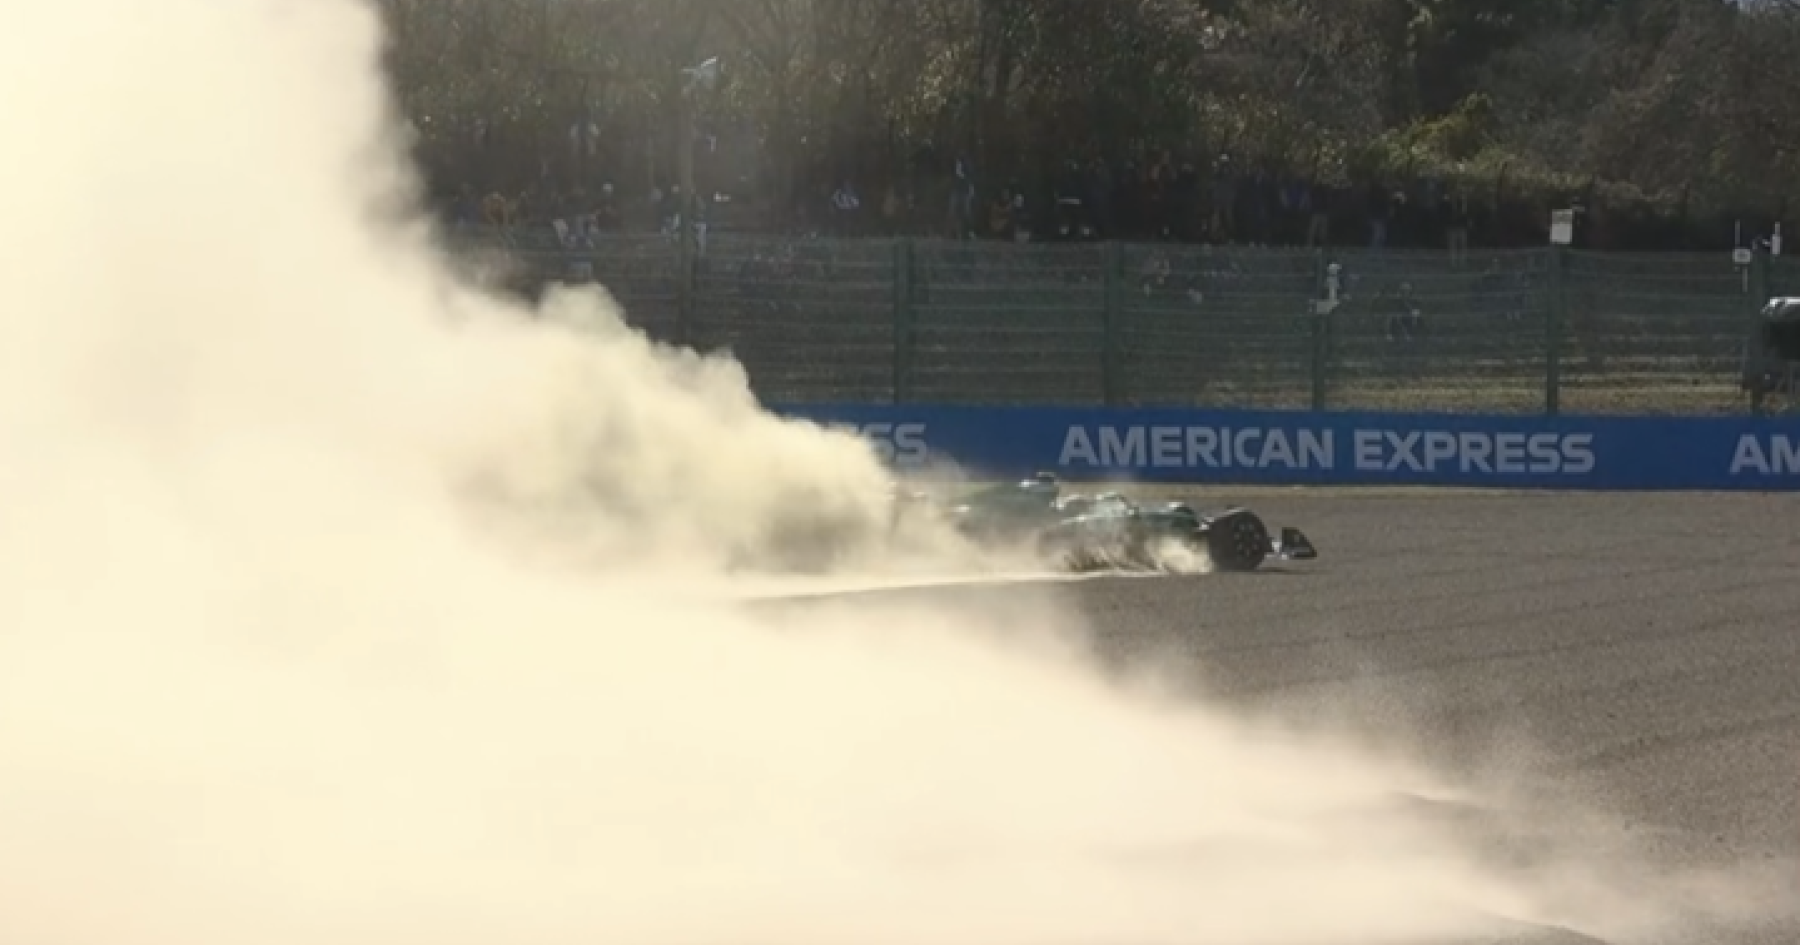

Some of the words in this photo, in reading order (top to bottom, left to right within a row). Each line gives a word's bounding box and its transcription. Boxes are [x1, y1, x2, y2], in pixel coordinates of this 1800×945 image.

[828, 422, 927, 467] SS
[1059, 424, 1335, 469] AMERICAN
[1354, 429, 1596, 473] EXPRESS
